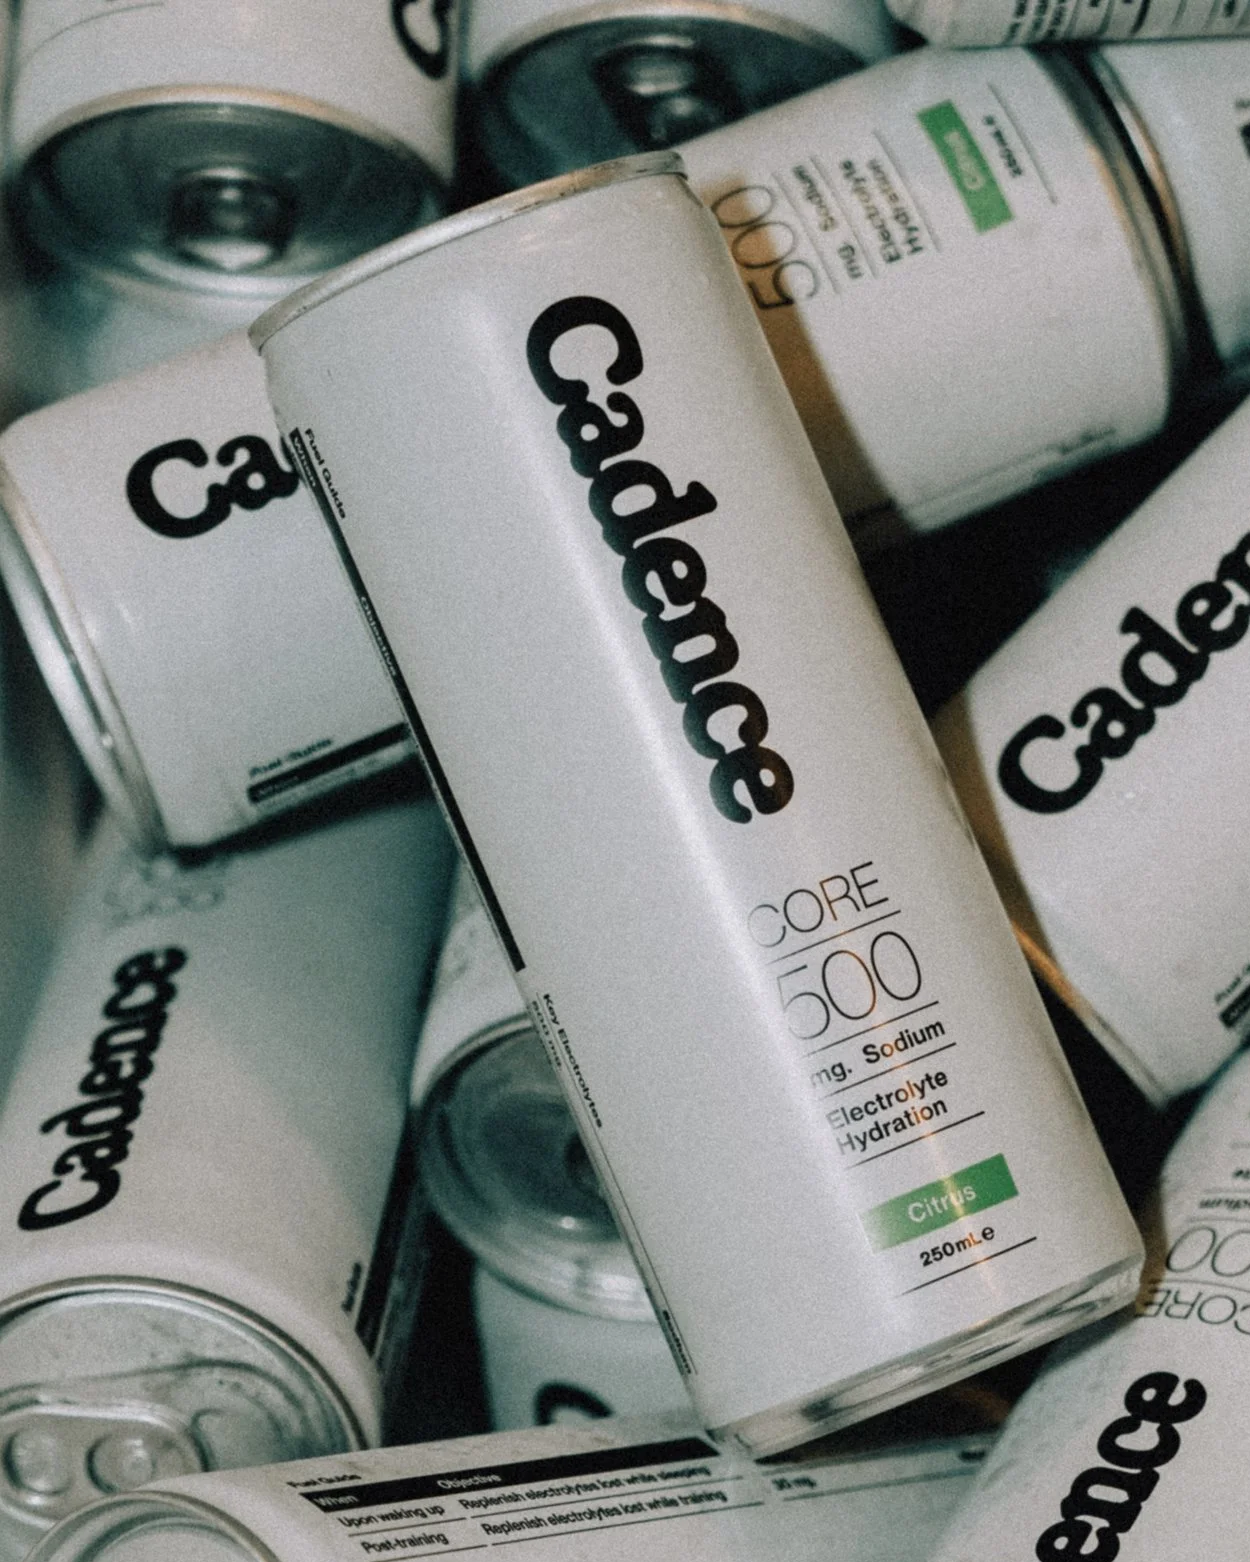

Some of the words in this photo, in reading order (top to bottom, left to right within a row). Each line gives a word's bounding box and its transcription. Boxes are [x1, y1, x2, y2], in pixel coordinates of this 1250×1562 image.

[711, 185, 820, 309] 500
[125, 434, 301, 540] Ca
[305, 427, 326, 468] Fuel
[322, 467, 346, 520] Guide
[526, 296, 795, 825] Cadence
[747, 861, 889, 948] CORE
[777, 931, 922, 1041] 500
[17, 946, 188, 1232] Cadence
[543, 993, 560, 1026] Key
[558, 1028, 602, 1128] Electrolytes
[811, 1060, 853, 1088] mg.
[862, 1019, 946, 1064] Sodium
[827, 1070, 949, 1130] Electrolyte
[837, 1099, 948, 1154] Hydration
[908, 1183, 978, 1223] Citrus
[338, 1515, 376, 1528] Upon
[378, 1507, 426, 1524] waking
[428, 1505, 445, 1516] up
[458, 1490, 524, 1510] Replenish
[525, 1481, 598, 1503] electrolytes
[599, 1479, 625, 1490] lost
[360, 1531, 449, 1554] Post-training
[481, 1514, 546, 1536] Replenish
[548, 1504, 621, 1527] electrolytes
[622, 1501, 647, 1513] lost
[649, 1494, 679, 1511] while
[679, 1489, 728, 1506] training
[437, 1473, 502, 1490] Objective
